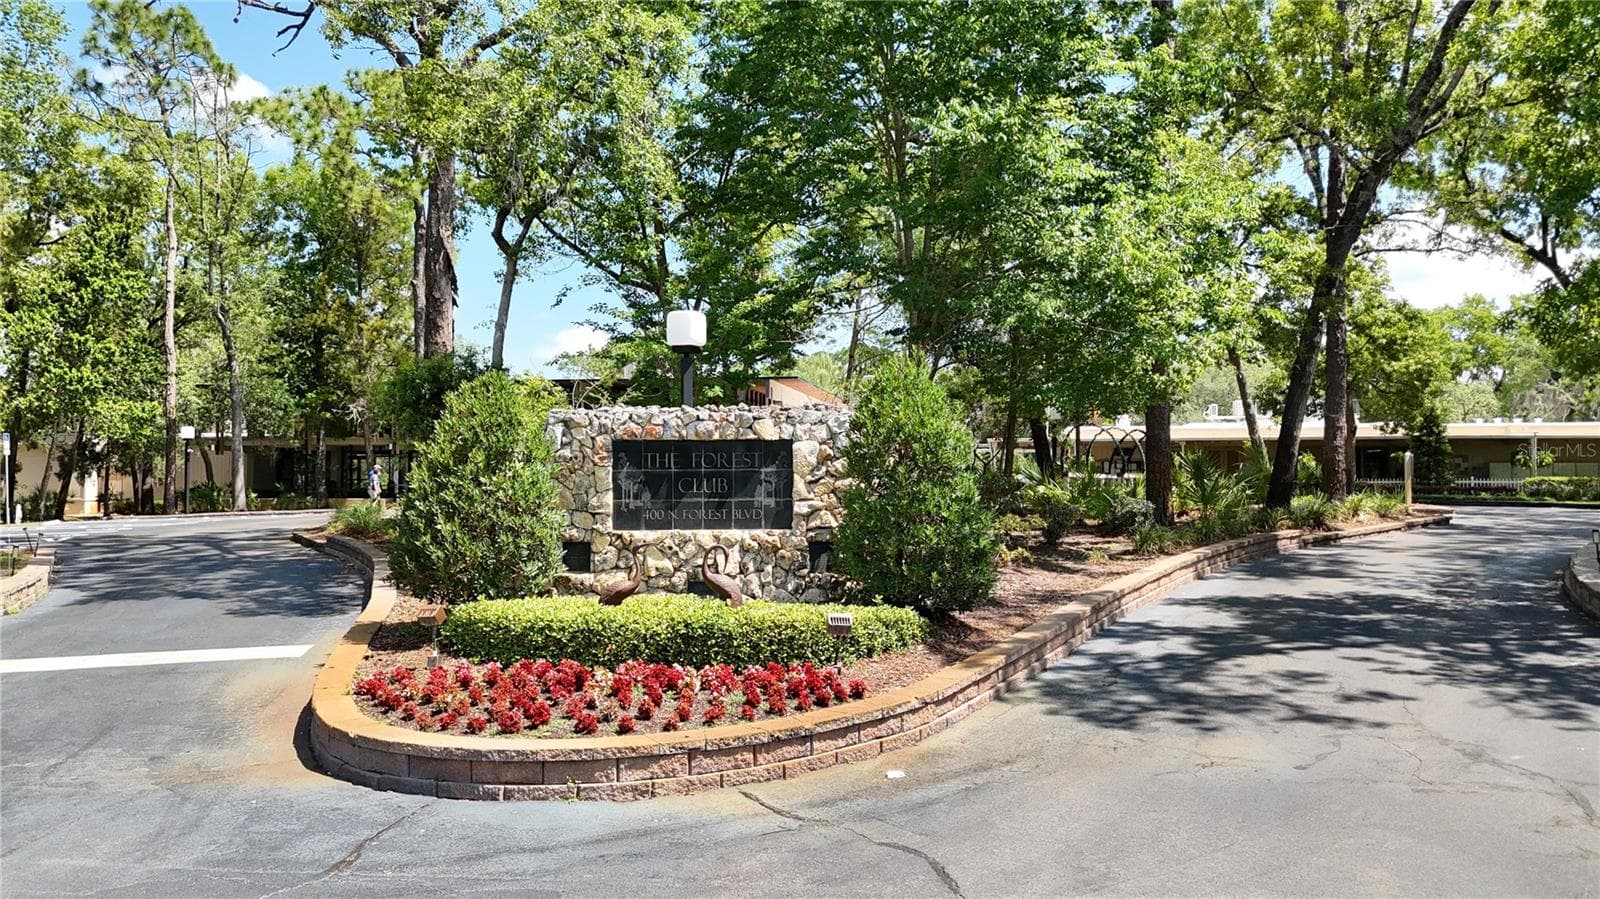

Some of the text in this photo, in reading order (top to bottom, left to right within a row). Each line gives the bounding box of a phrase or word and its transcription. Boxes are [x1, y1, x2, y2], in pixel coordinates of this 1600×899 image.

[644, 452, 762, 469] THE FOREST
[678, 477, 728, 493] CLUB
[643, 509, 664, 520] 400
[682, 508, 728, 520] FOREST
[732, 509, 763, 520] BLVD
